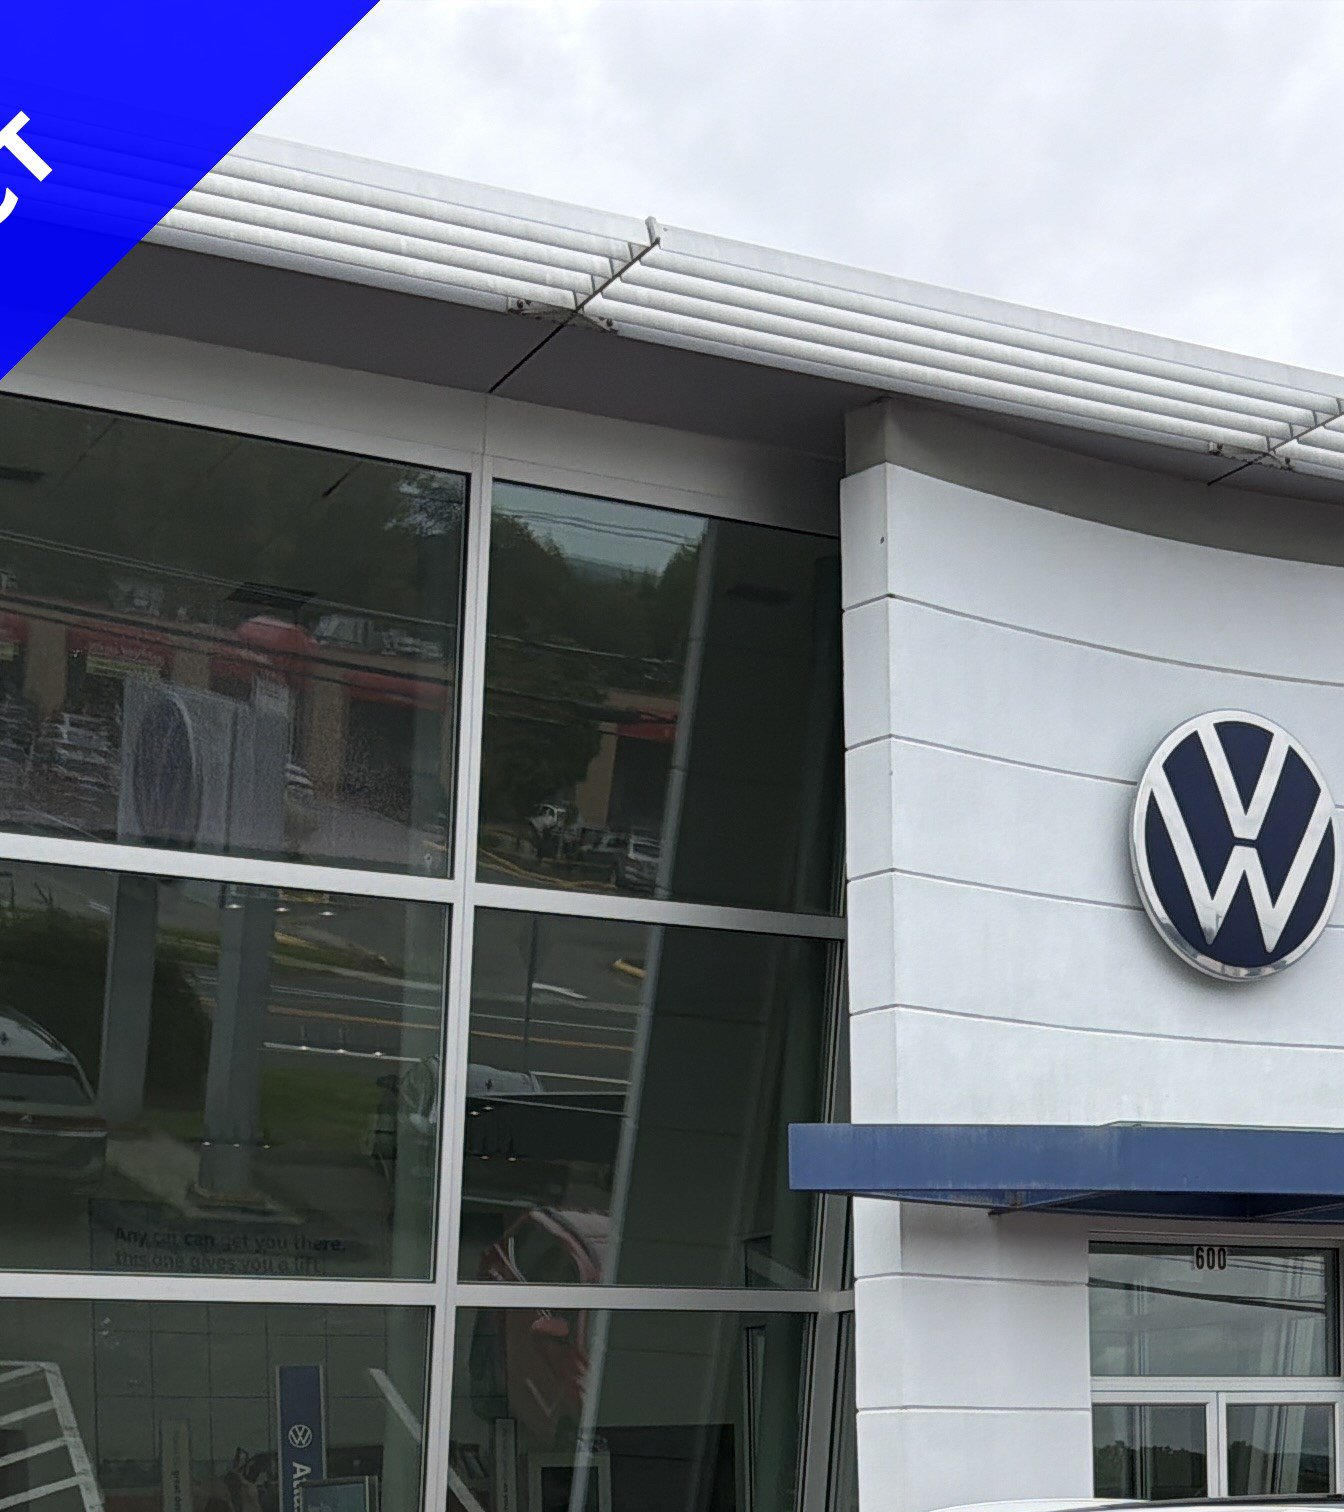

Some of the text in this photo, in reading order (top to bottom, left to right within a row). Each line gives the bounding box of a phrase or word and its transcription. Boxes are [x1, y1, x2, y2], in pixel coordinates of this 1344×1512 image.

[114, 1227, 147, 1248] Any
[184, 1232, 215, 1247] can
[1196, 1246, 1227, 1270] 600
